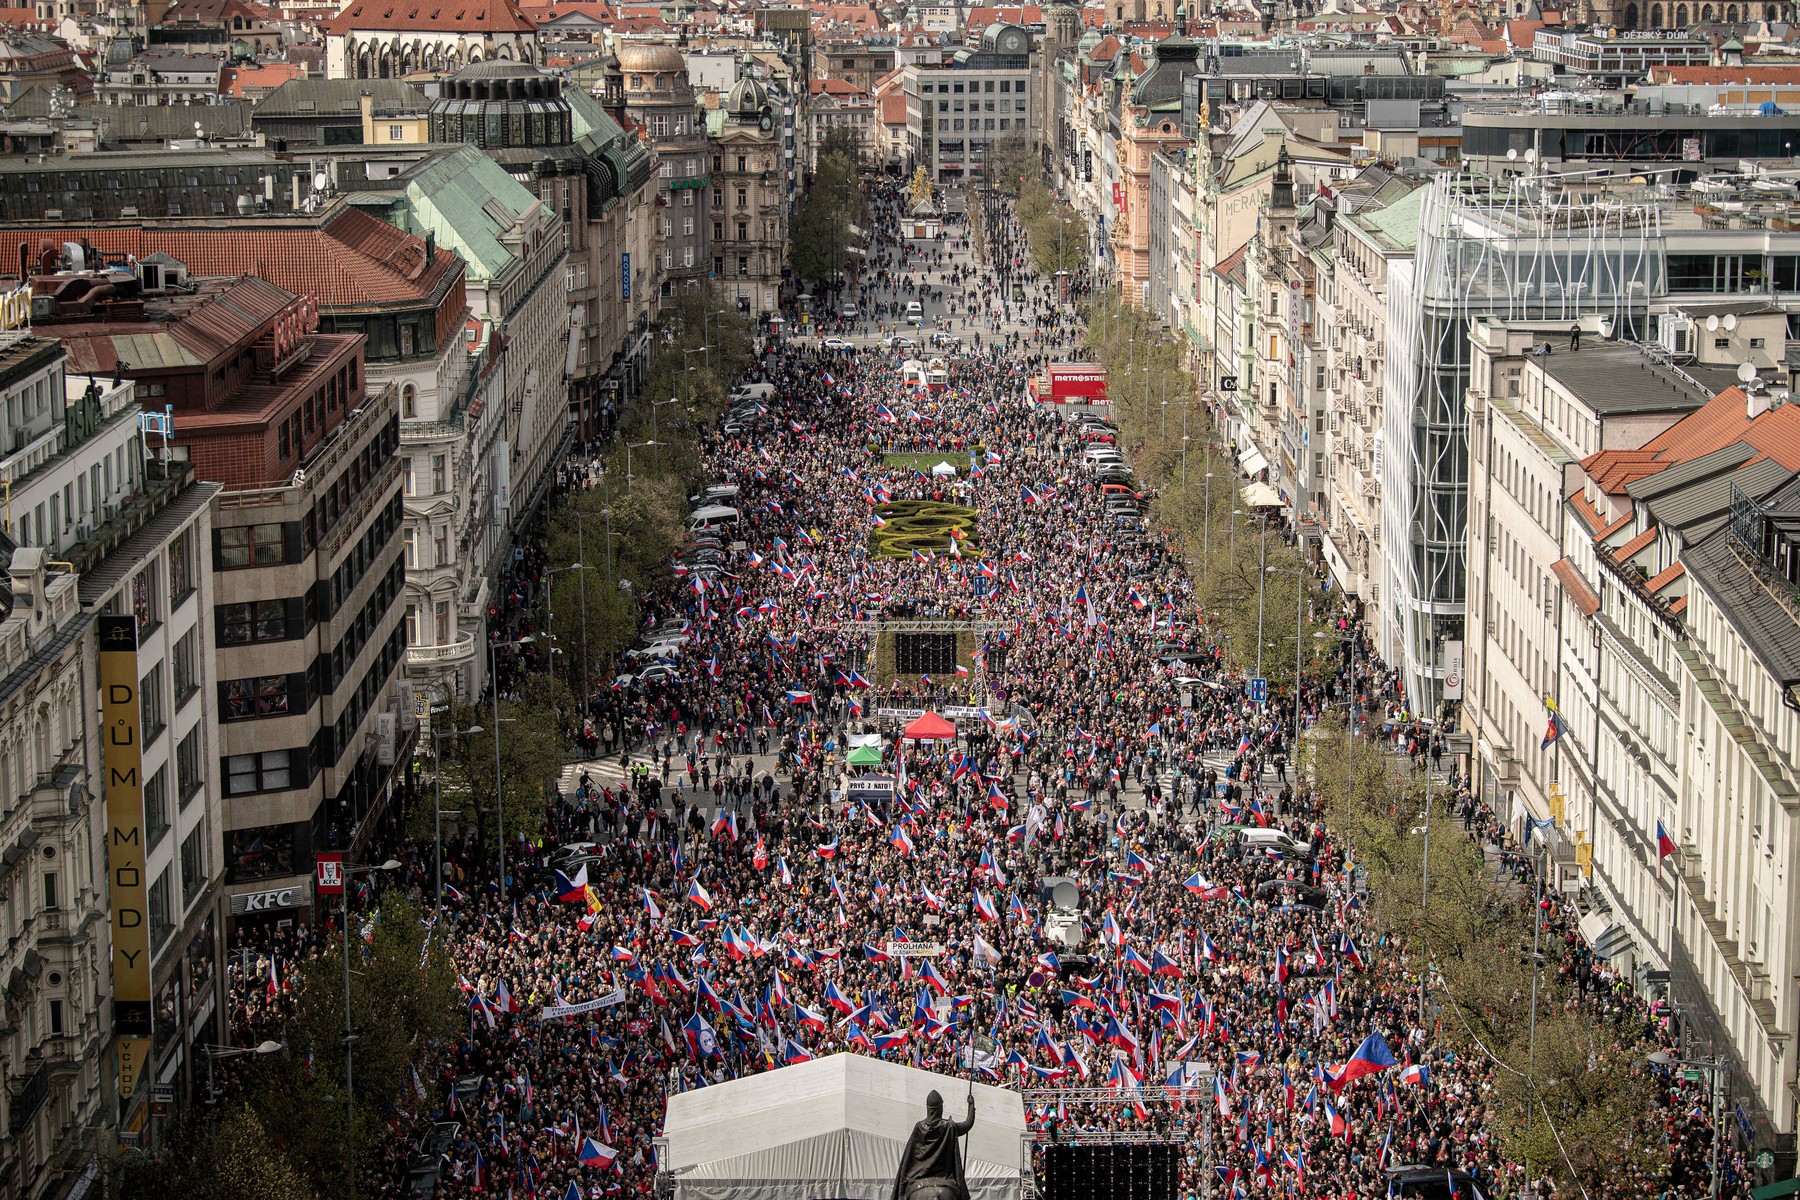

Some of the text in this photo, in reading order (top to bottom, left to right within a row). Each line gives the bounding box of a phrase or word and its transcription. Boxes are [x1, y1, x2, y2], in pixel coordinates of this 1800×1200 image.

[1623, 29, 1689, 39] DĚTSKÝ DŮM
[1225, 189, 1264, 216] MERAN
[110, 684, 136, 787] DŮM
[114, 826, 142, 969] MÓDY
[244, 889, 293, 912] KFC
[122, 1042, 132, 1093] VCHOD
